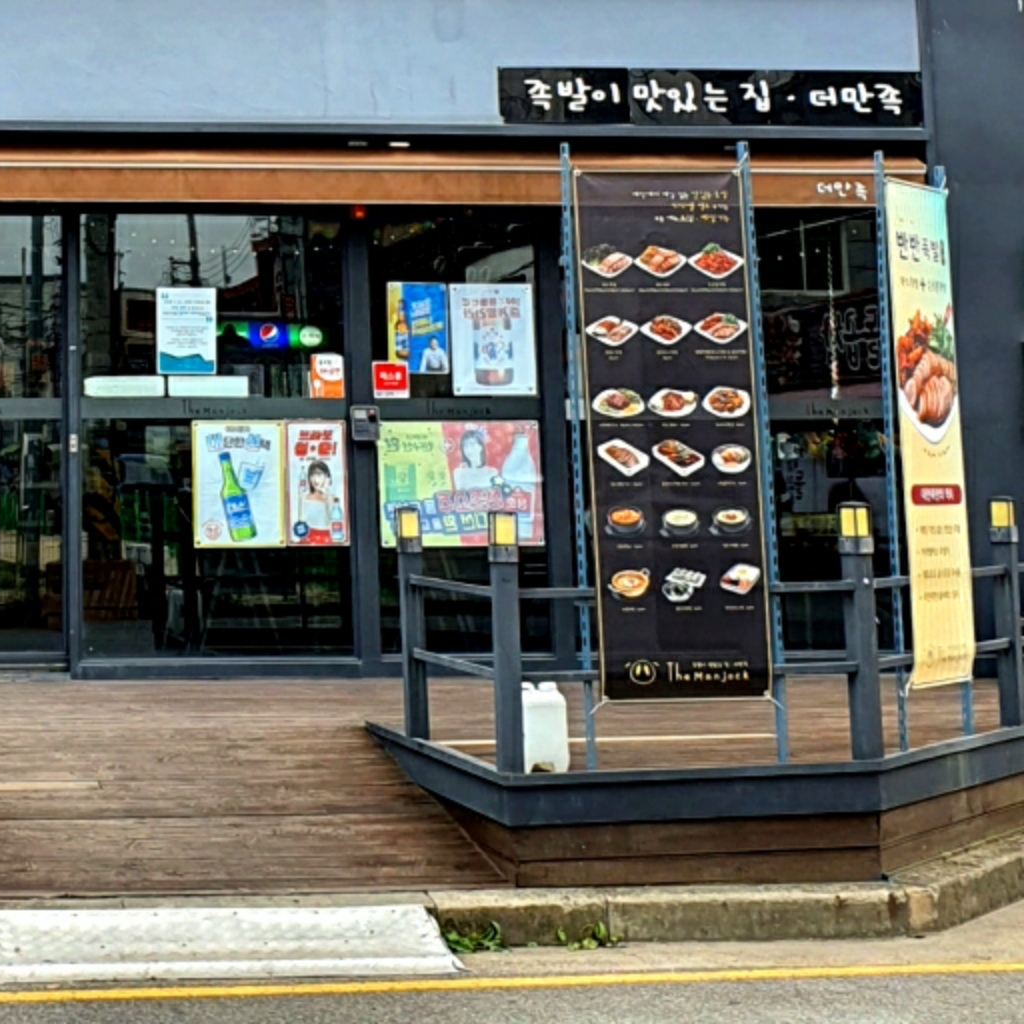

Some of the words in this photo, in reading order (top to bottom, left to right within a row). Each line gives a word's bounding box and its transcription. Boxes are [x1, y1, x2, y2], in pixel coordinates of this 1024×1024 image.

[523, 77, 621, 113] 족발이
[632, 79, 729, 114] 맛있는
[738, 81, 771, 114] 집
[808, 82, 904, 115] 더만족
[816, 180, 868, 201] 더만족
[665, 661, 691, 683] The
